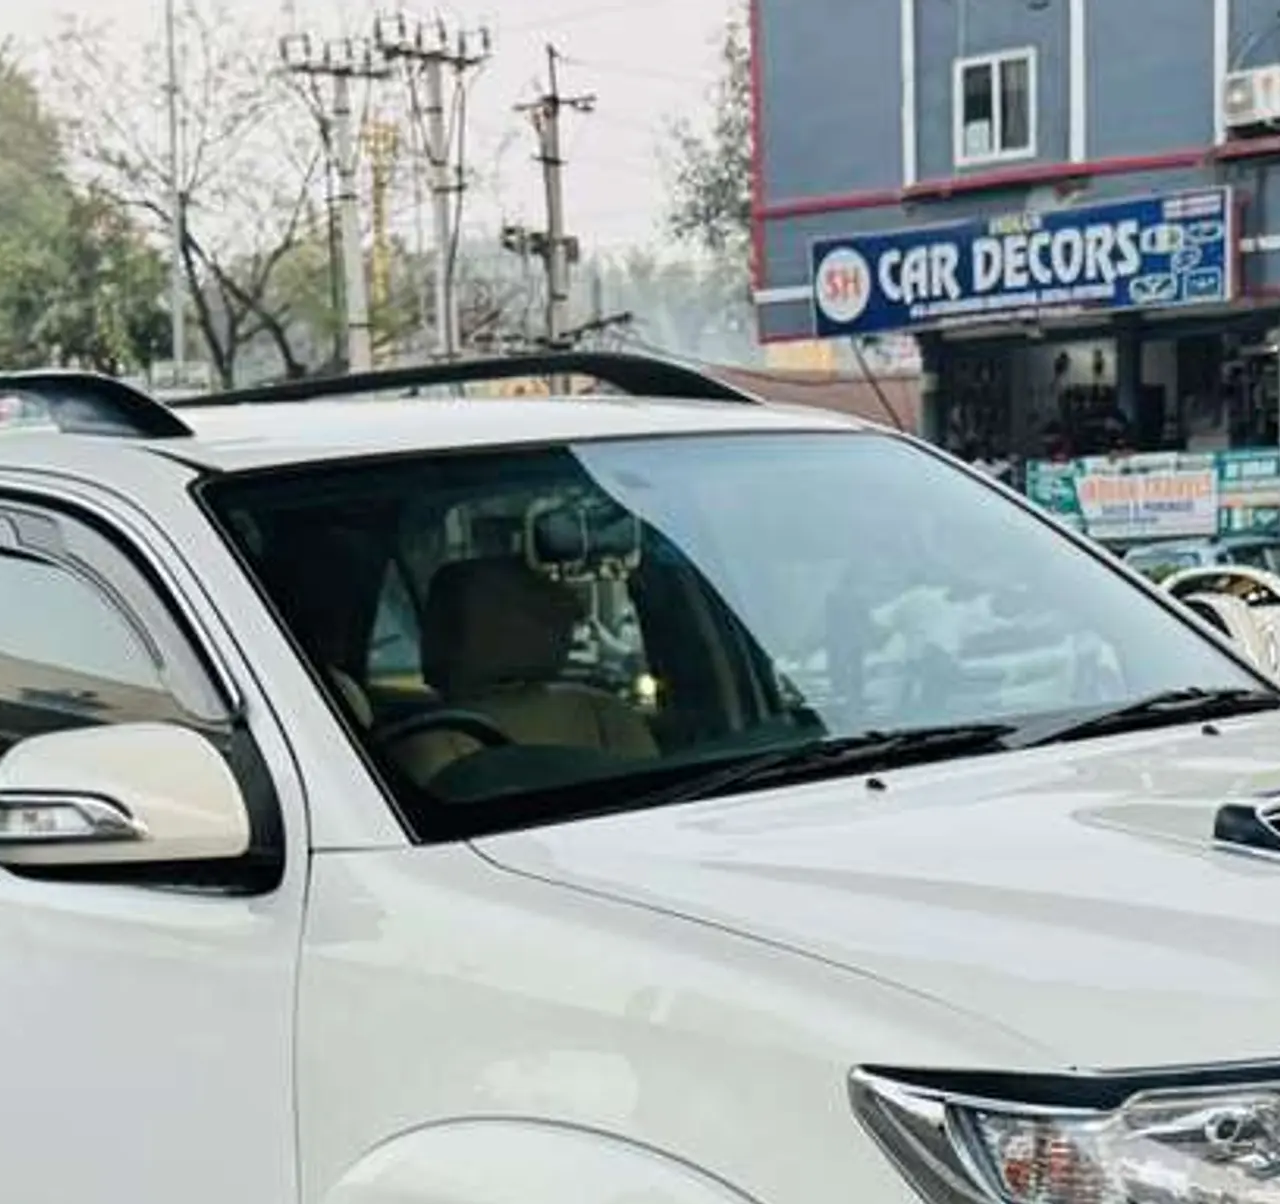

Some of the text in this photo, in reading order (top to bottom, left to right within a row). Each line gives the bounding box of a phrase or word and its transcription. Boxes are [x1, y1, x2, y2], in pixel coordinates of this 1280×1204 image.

[823, 263, 862, 300] SH
[877, 243, 961, 305] CAR
[973, 219, 1141, 292] DECORS
